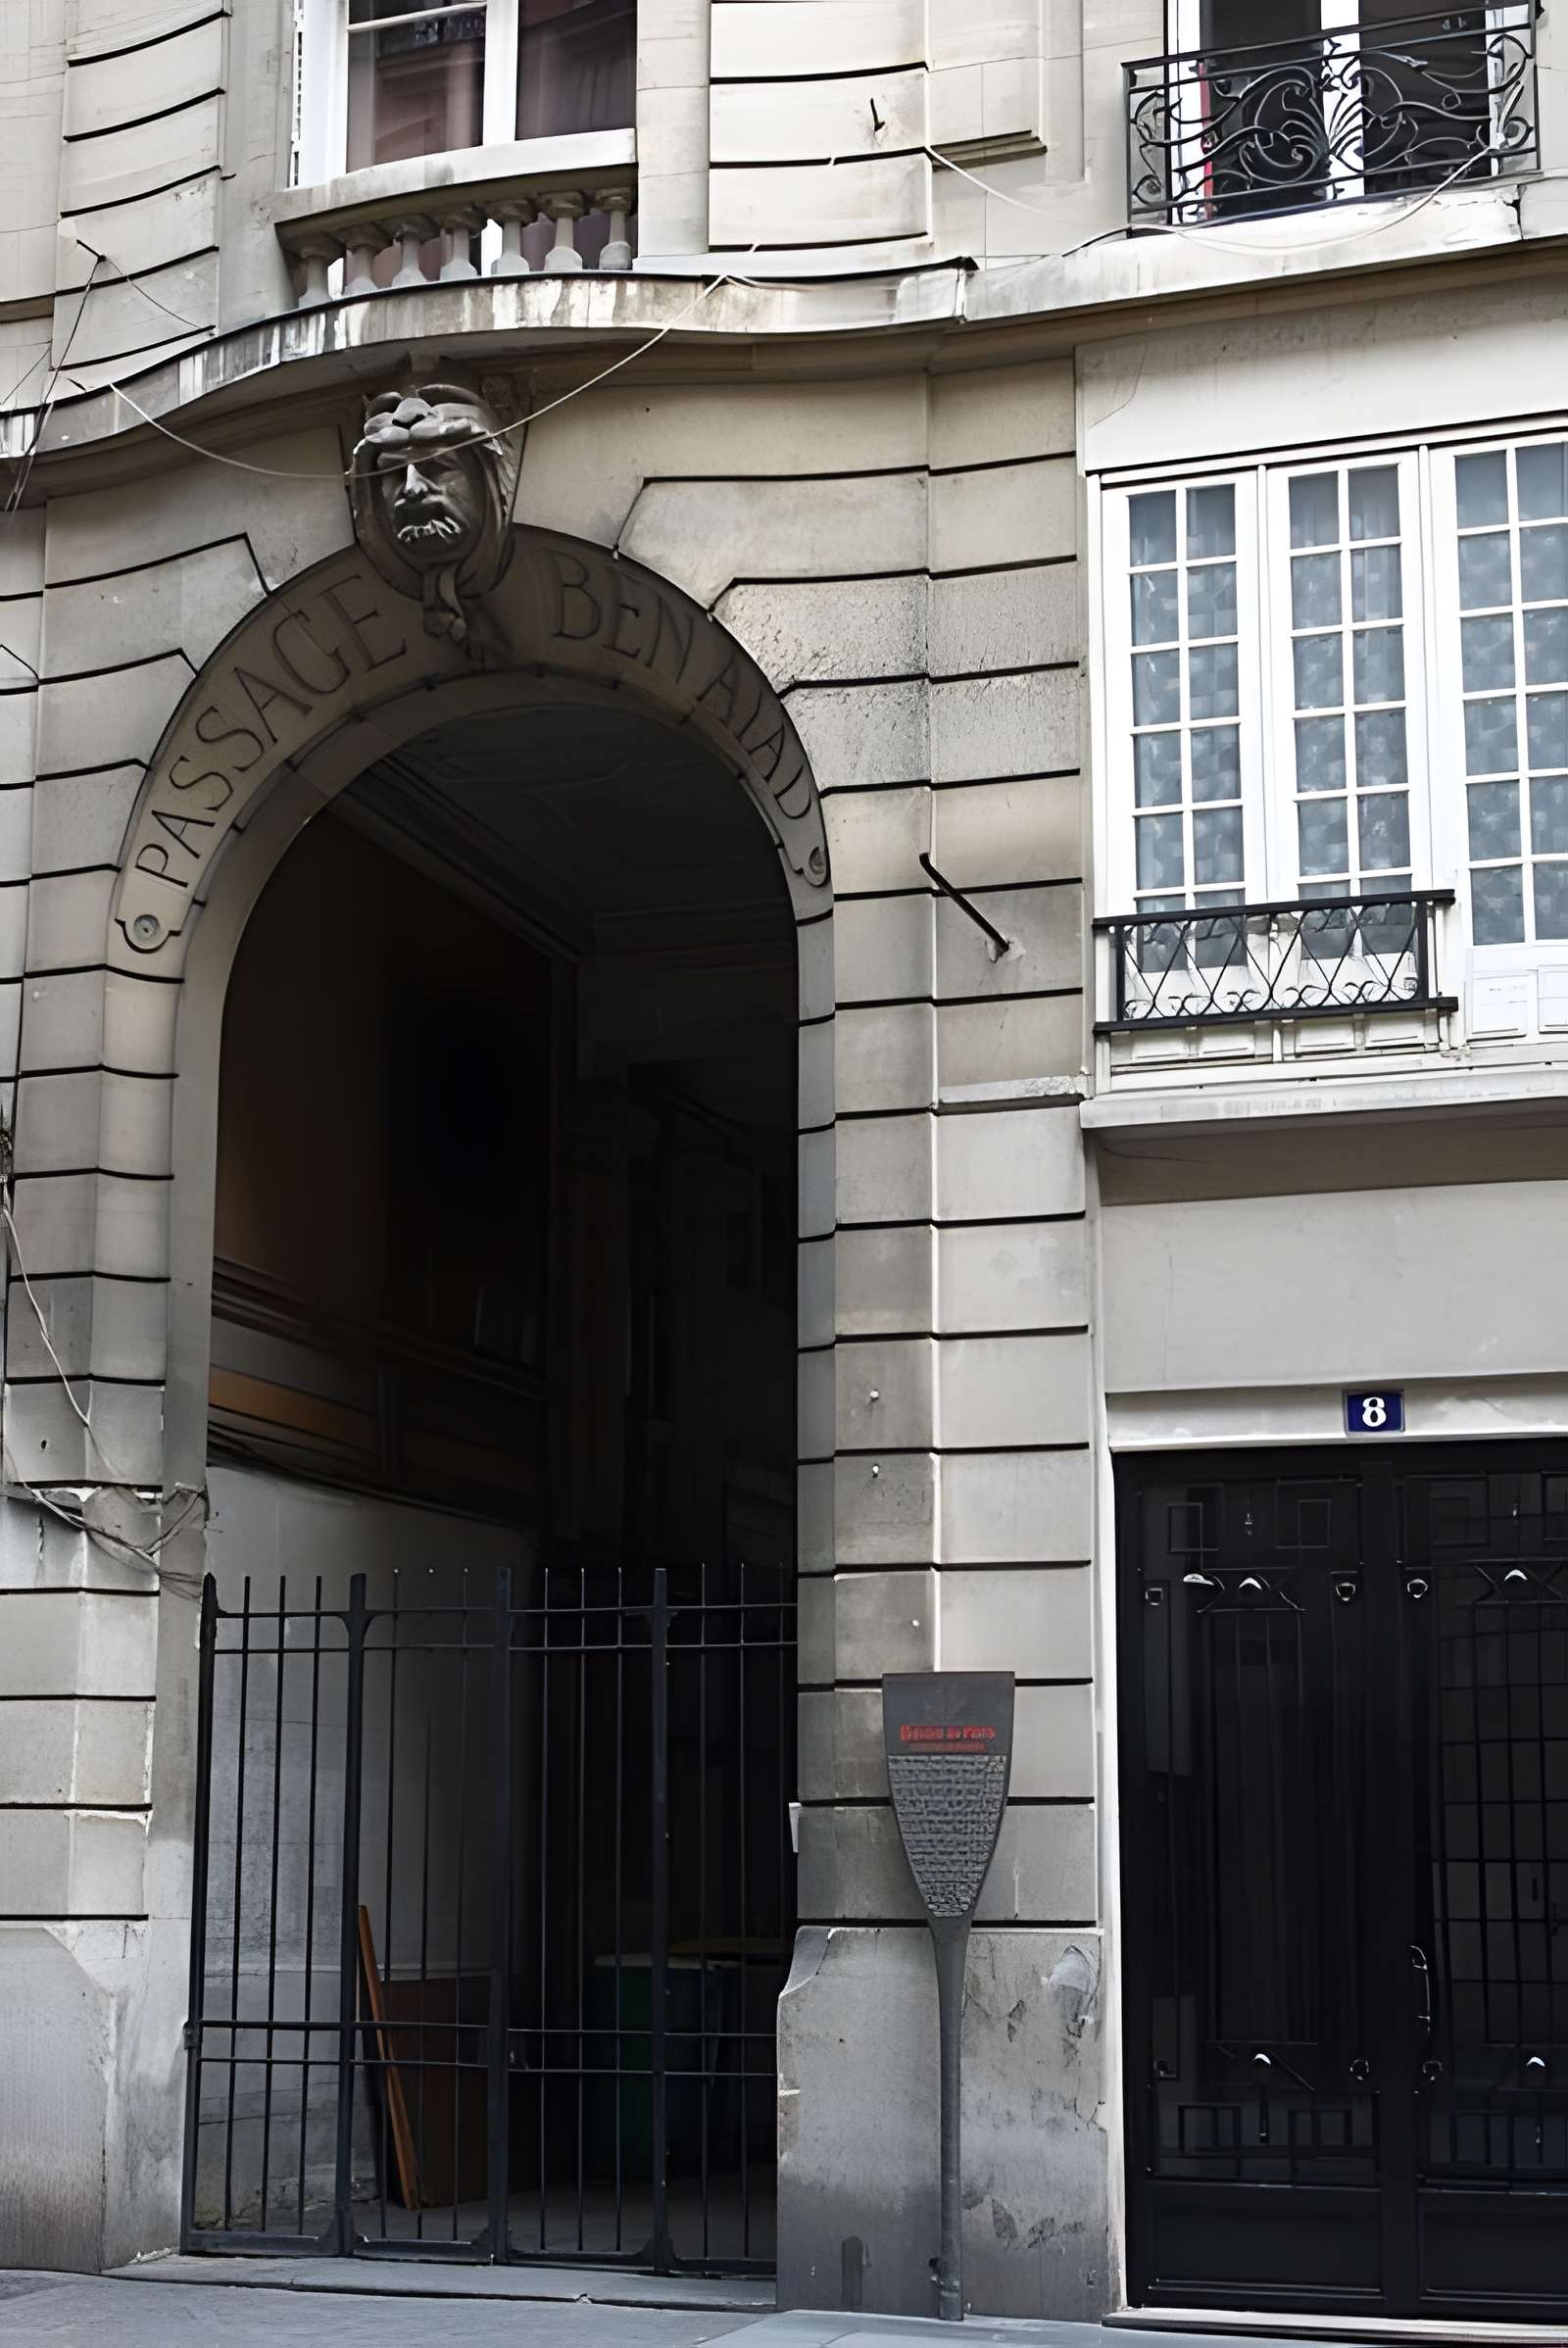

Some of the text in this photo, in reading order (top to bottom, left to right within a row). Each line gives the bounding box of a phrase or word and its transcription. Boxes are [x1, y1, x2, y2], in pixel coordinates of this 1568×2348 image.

[134, 573, 408, 889] PASSAGE
[543, 548, 694, 685] BEN
[1362, 1396, 1387, 1427] 8
